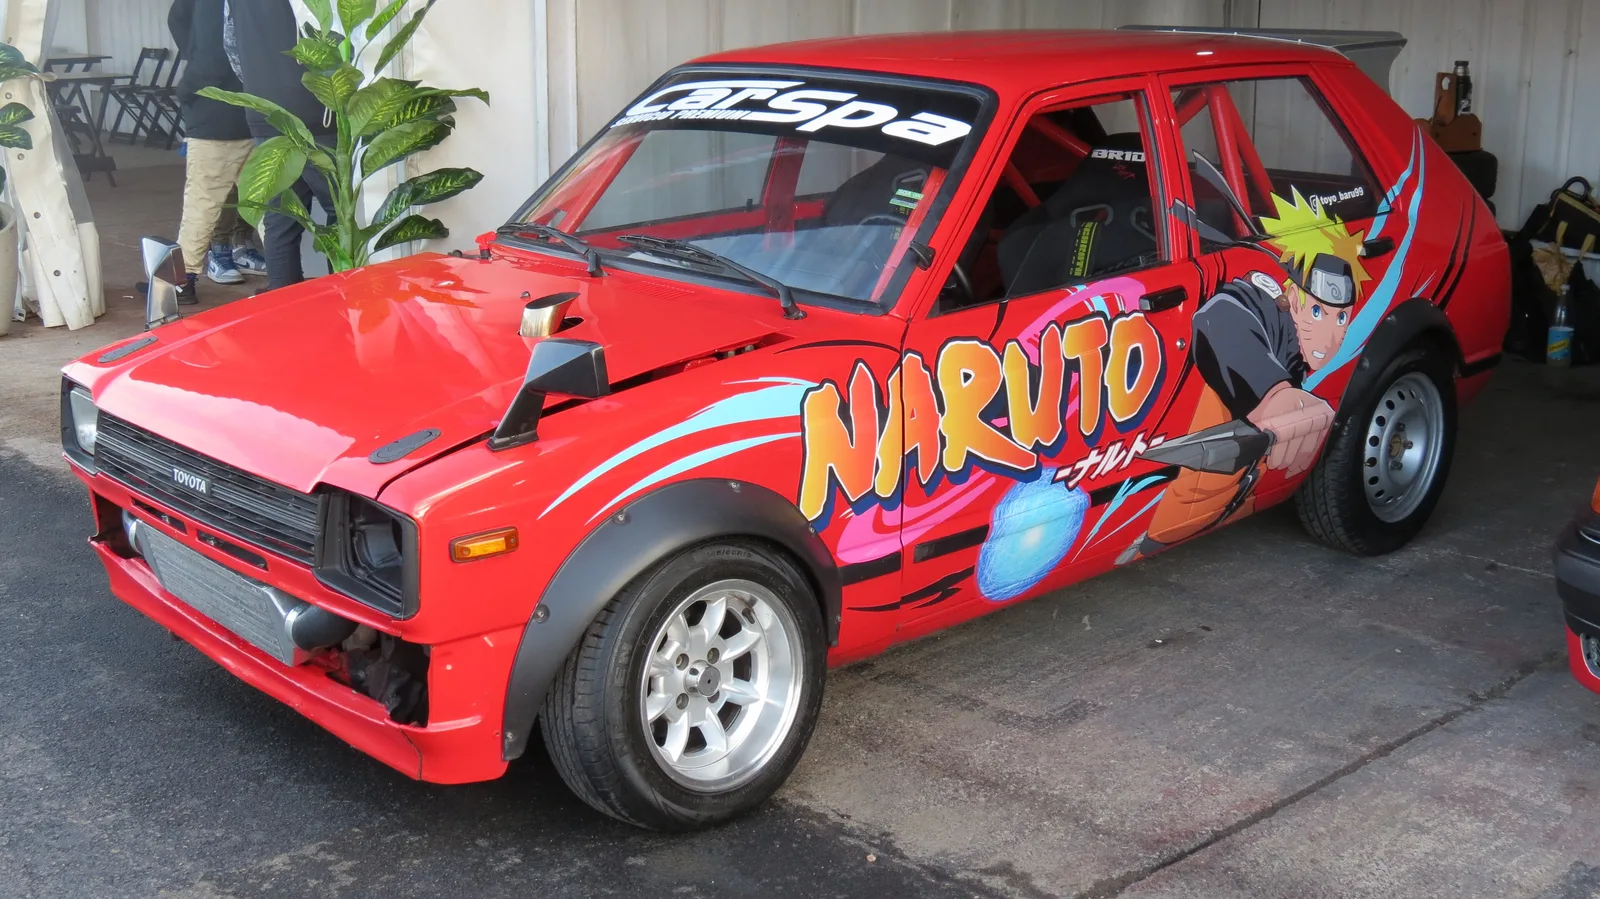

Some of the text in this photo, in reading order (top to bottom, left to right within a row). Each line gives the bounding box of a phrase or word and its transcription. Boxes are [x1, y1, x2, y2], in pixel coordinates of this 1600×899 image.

[669, 109, 751, 120] PREMIUM
[1091, 149, 1146, 162] BRID
[1320, 186, 1364, 206] toyo_baru99
[799, 312, 1164, 523] NARUTO
[173, 468, 207, 494] TOYOTA
